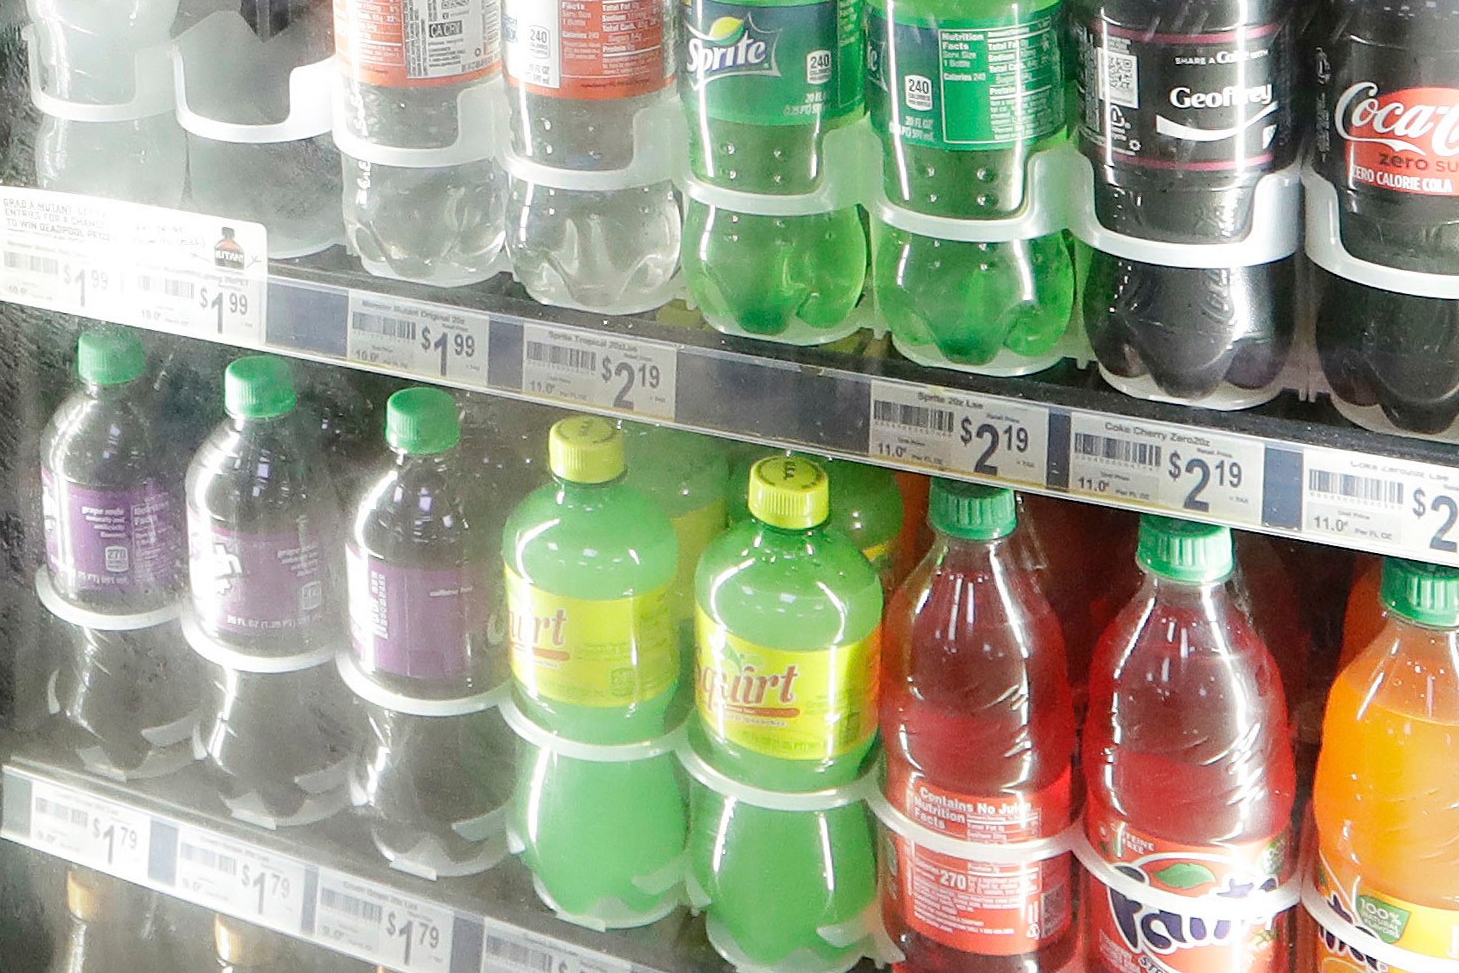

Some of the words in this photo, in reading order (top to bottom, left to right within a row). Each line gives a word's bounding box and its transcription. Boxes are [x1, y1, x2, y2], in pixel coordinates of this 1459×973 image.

[530, 29, 548, 44] 240
[942, 31, 984, 41] Nutrition
[942, 41, 970, 50] Facts
[686, 38, 767, 74] Sprite
[810, 54, 830, 69] 240
[1174, 55, 1206, 66] SHARE
[908, 78, 930, 94] 240
[1334, 80, 1459, 159] Coca-C
[1378, 150, 1429, 172] zero
[1350, 163, 1375, 183] ZERO
[1376, 170, 1420, 191] CALORIE
[1422, 178, 1453, 193] COLA
[63, 263, 108, 309] $199
[199, 285, 248, 335] $199
[421, 325, 475, 377] $199
[601, 355, 660, 411] $219
[918, 391, 945, 405] Sprite
[1104, 420, 1131, 434] Coke
[1132, 425, 1166, 442] Cherry
[960, 415, 1029, 477] $219
[1168, 450, 1242, 512] $219
[914, 795, 966, 823] Nutrition
[919, 785, 974, 812] Contains
[977, 799, 996, 814] No
[914, 807, 946, 829] Facts
[93, 817, 138, 865] $179
[242, 863, 291, 915] $179
[940, 871, 966, 891] 270
[387, 911, 440, 966] $179
